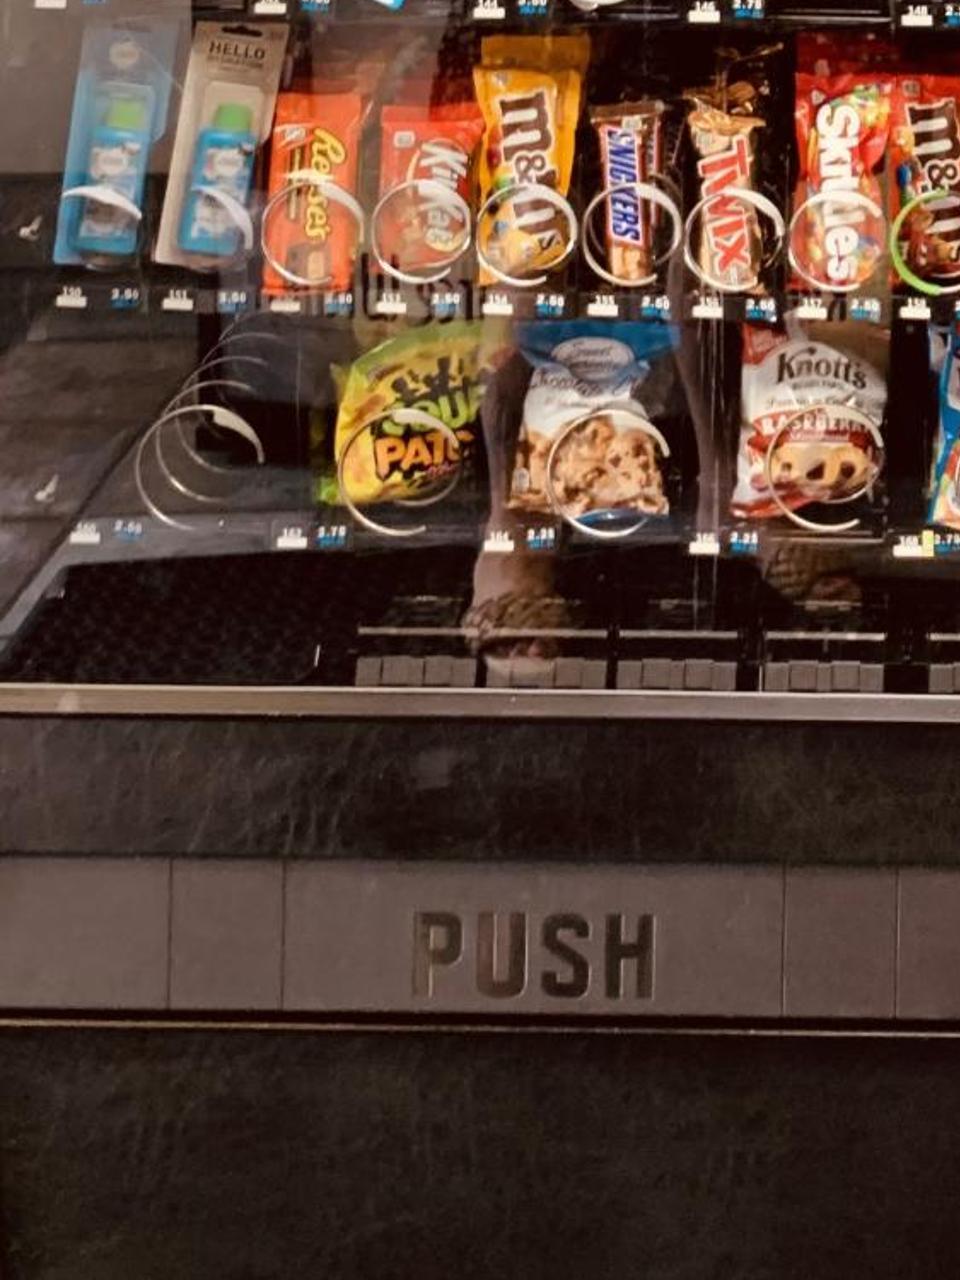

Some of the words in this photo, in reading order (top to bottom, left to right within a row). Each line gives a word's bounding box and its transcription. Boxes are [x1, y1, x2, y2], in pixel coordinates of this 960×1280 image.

[209, 41, 265, 60] HELLO
[606, 129, 641, 242] SNICKERS
[698, 136, 753, 275] TWIX
[816, 102, 866, 281] Skittles
[777, 351, 867, 390] Knott's
[413, 910, 655, 1000] PUSH
